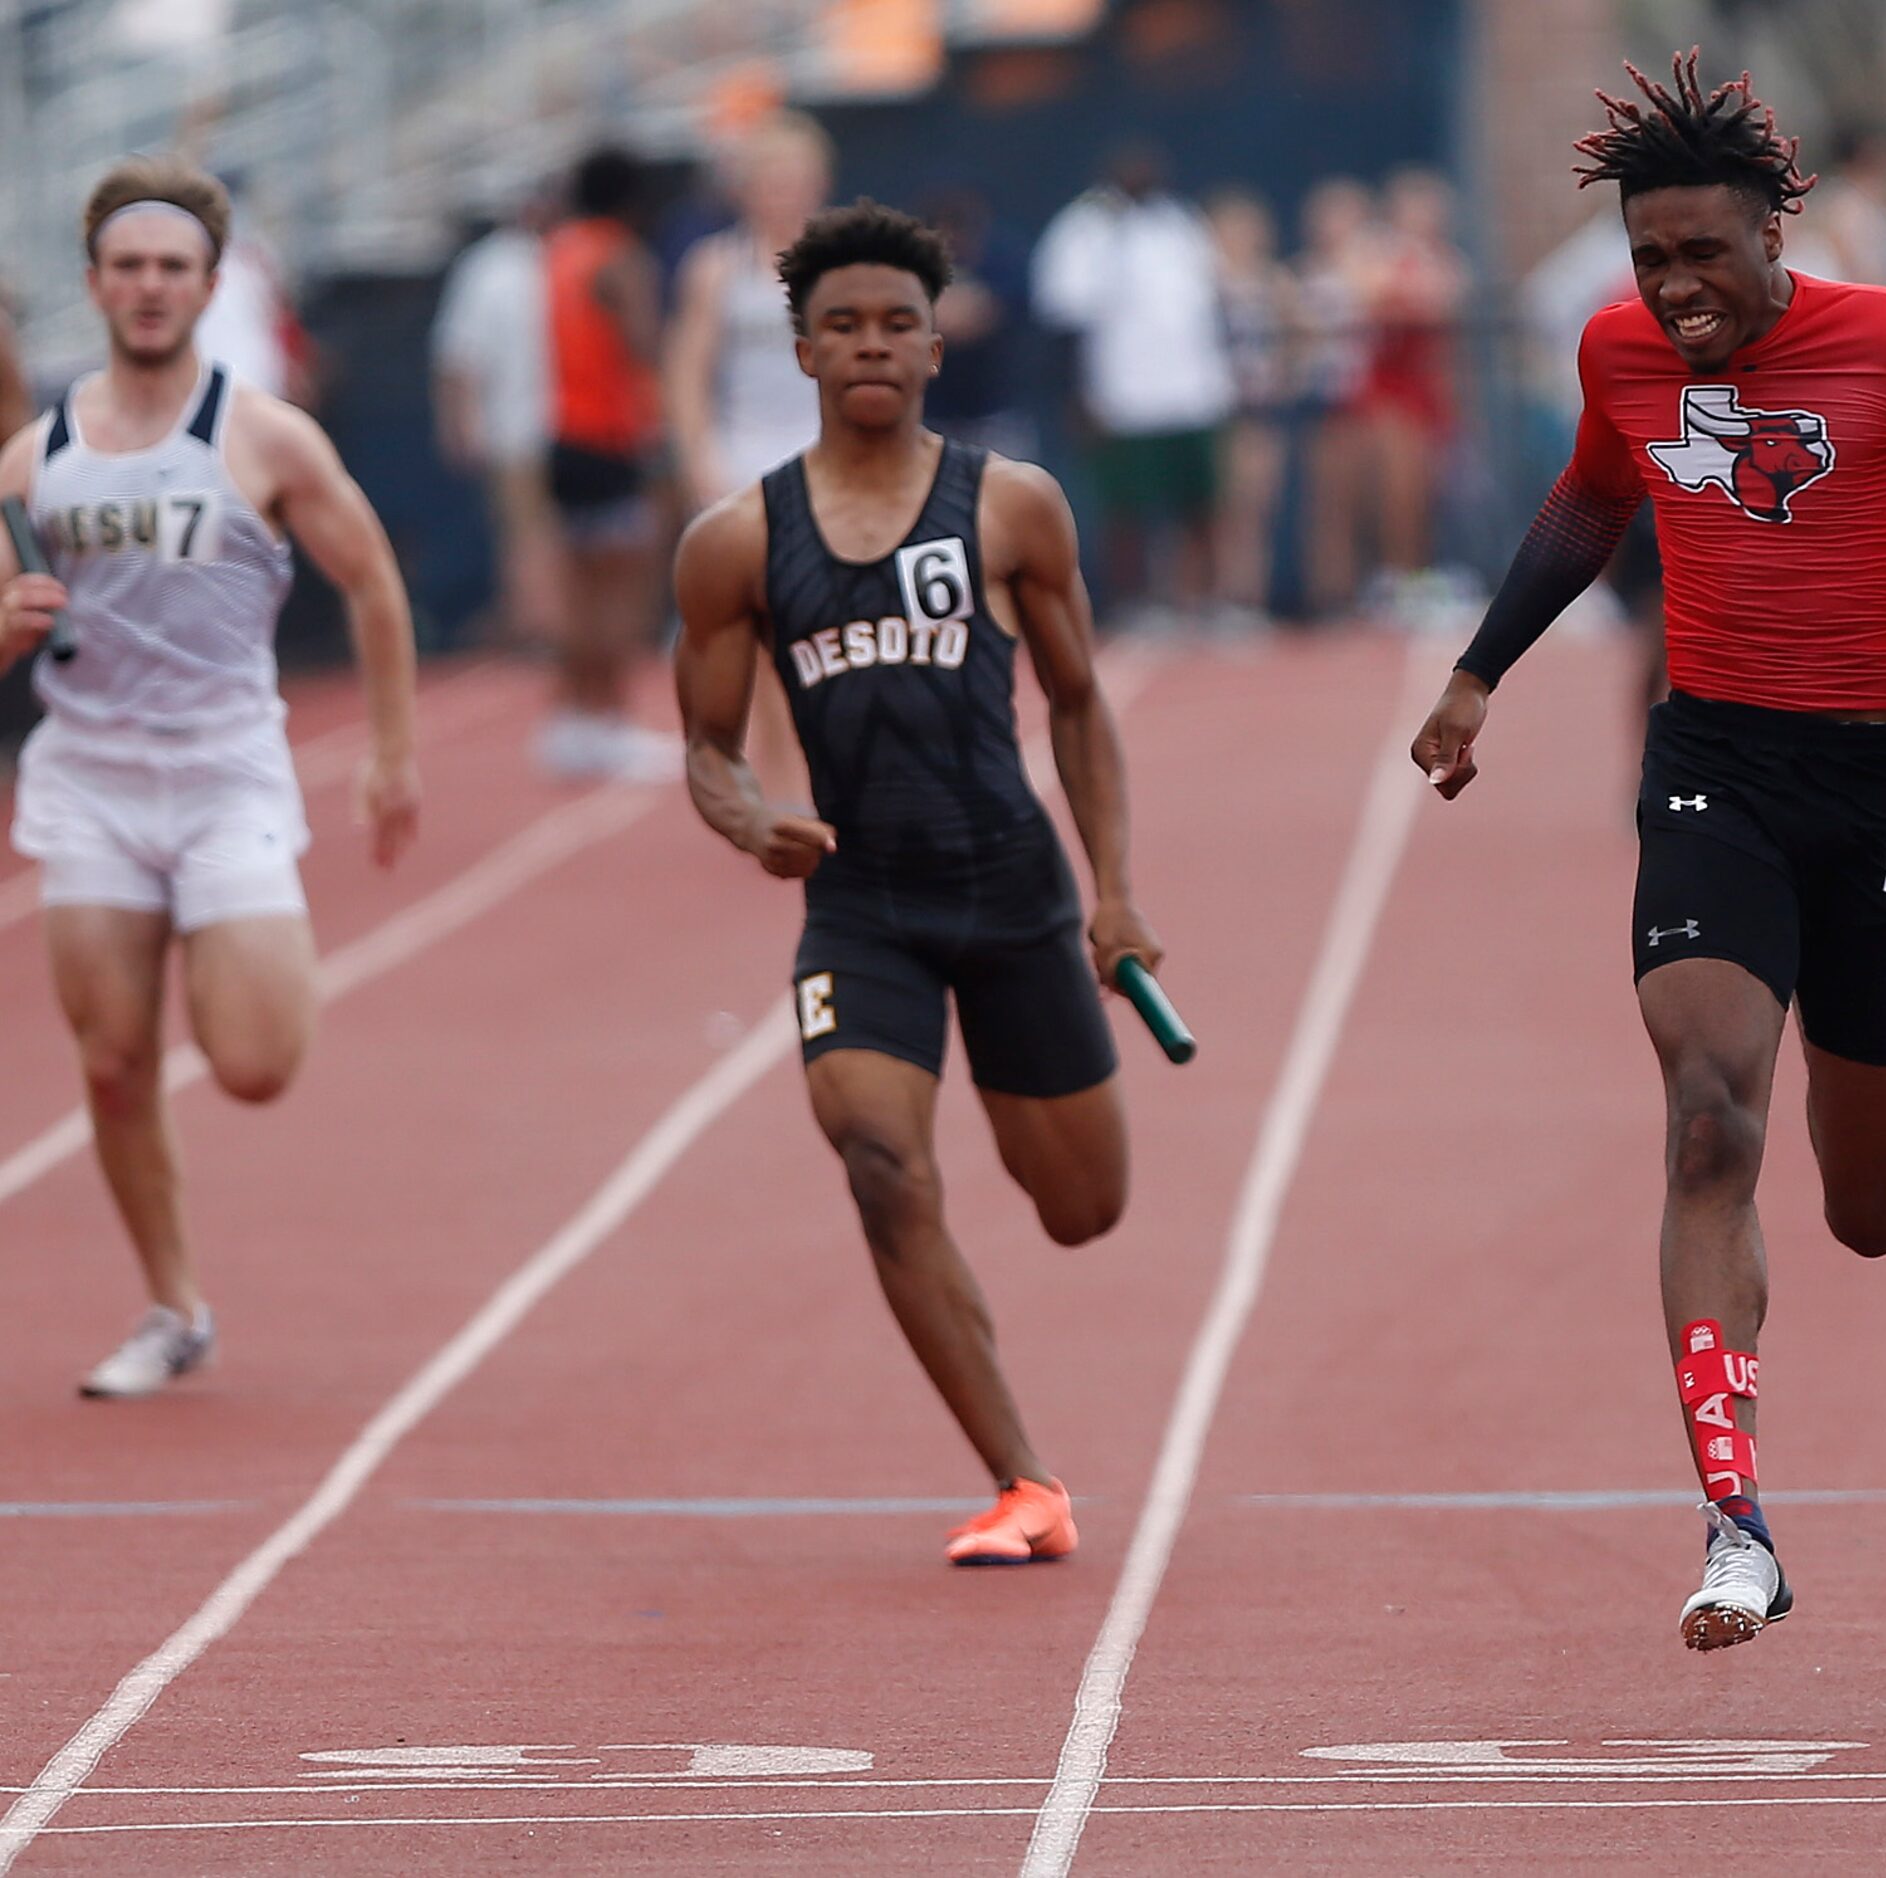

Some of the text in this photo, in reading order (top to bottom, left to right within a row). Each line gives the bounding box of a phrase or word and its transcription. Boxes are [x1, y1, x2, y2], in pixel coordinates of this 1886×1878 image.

[170, 501, 203, 557] 7
[913, 552, 964, 620] 6
[788, 615, 969, 689] DESOTO
[799, 971, 838, 1041] E
